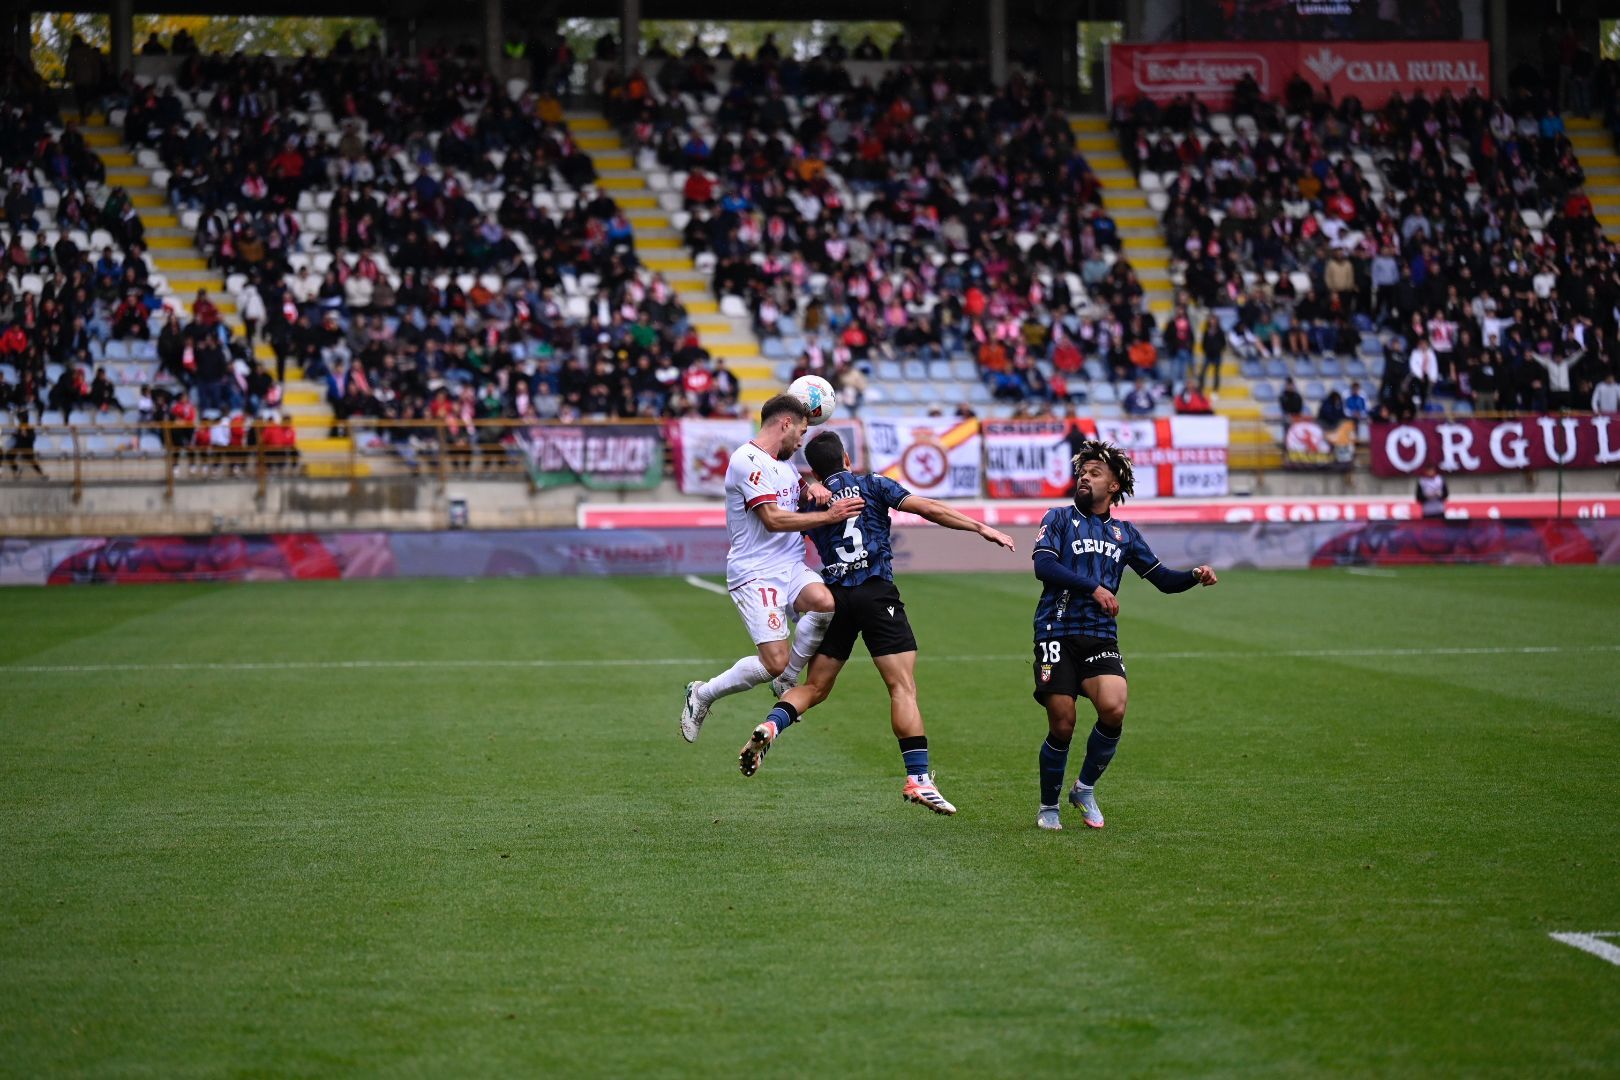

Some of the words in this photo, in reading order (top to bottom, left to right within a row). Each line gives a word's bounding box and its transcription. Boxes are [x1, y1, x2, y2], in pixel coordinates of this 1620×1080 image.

[1346, 60, 1401, 82] CAJA
[1407, 60, 1485, 82] RURAL
[1385, 415, 1620, 473] ORGUL
[827, 485, 860, 507] ATOS
[1071, 538, 1122, 562] CEUTA
[758, 587, 777, 608] 17
[1039, 640, 1061, 663] 18
